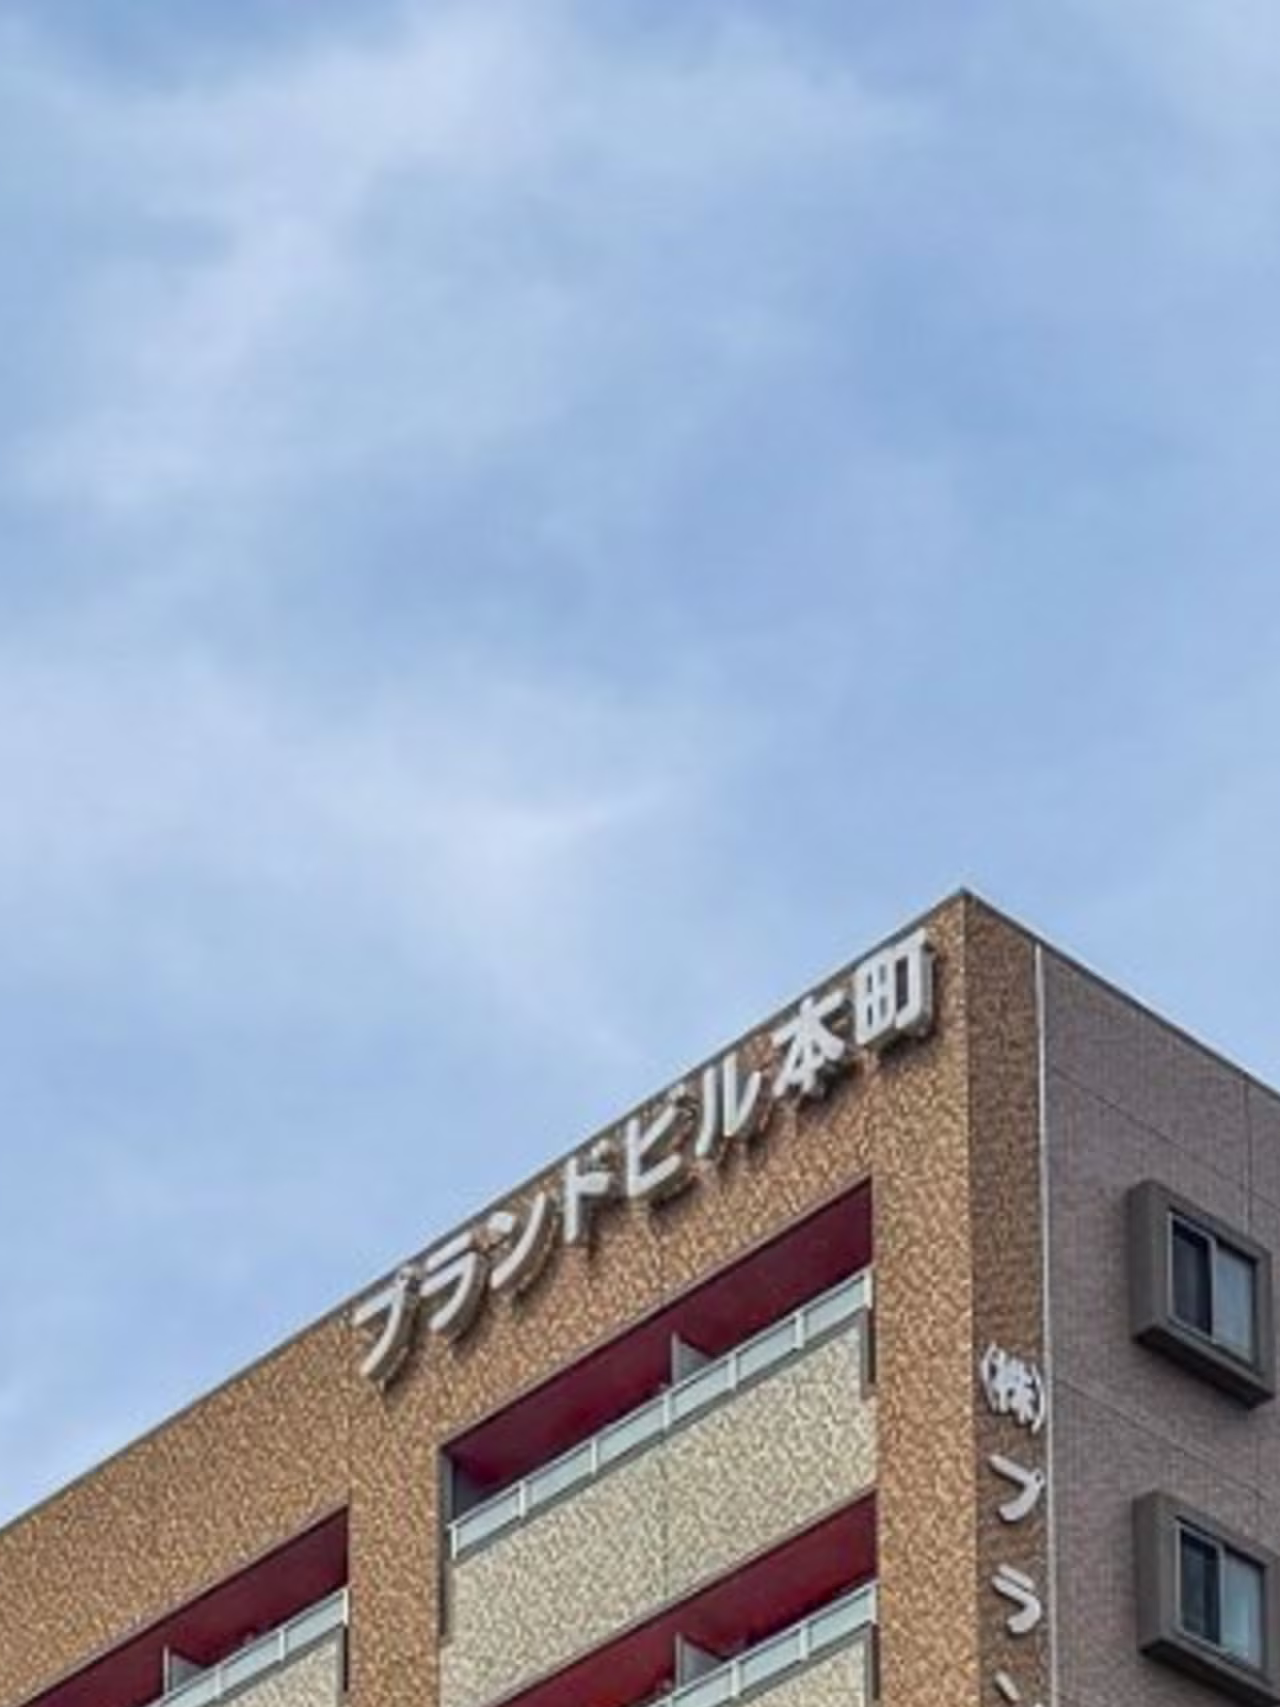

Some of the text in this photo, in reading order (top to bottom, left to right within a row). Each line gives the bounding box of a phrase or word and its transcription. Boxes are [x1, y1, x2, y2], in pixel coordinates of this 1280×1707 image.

[354, 928, 934, 1380] ブランドビル本町
